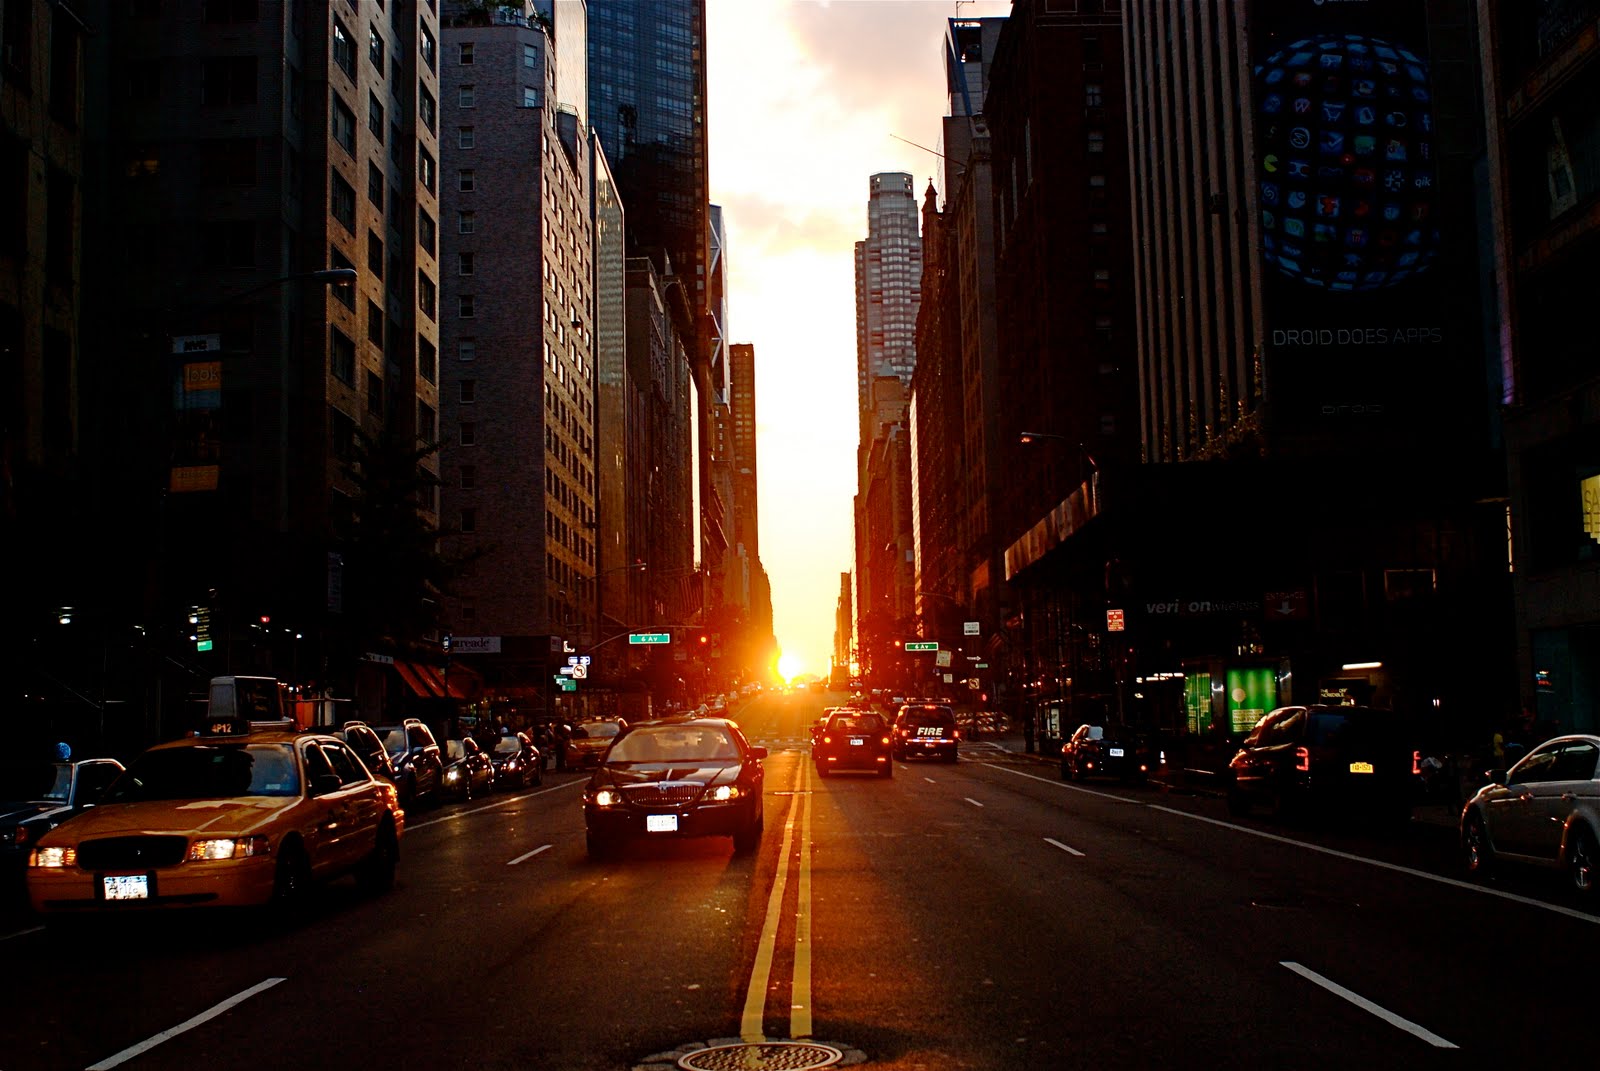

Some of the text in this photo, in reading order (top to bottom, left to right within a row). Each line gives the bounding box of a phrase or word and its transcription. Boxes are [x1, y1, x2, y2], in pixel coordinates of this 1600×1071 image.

[1273, 327, 1442, 345] DROID DOES APPS
[186, 365, 218, 382] look
[1146, 598, 1211, 613] verion
[211, 723, 232, 733] 4P12
[917, 727, 944, 736] FIRE
